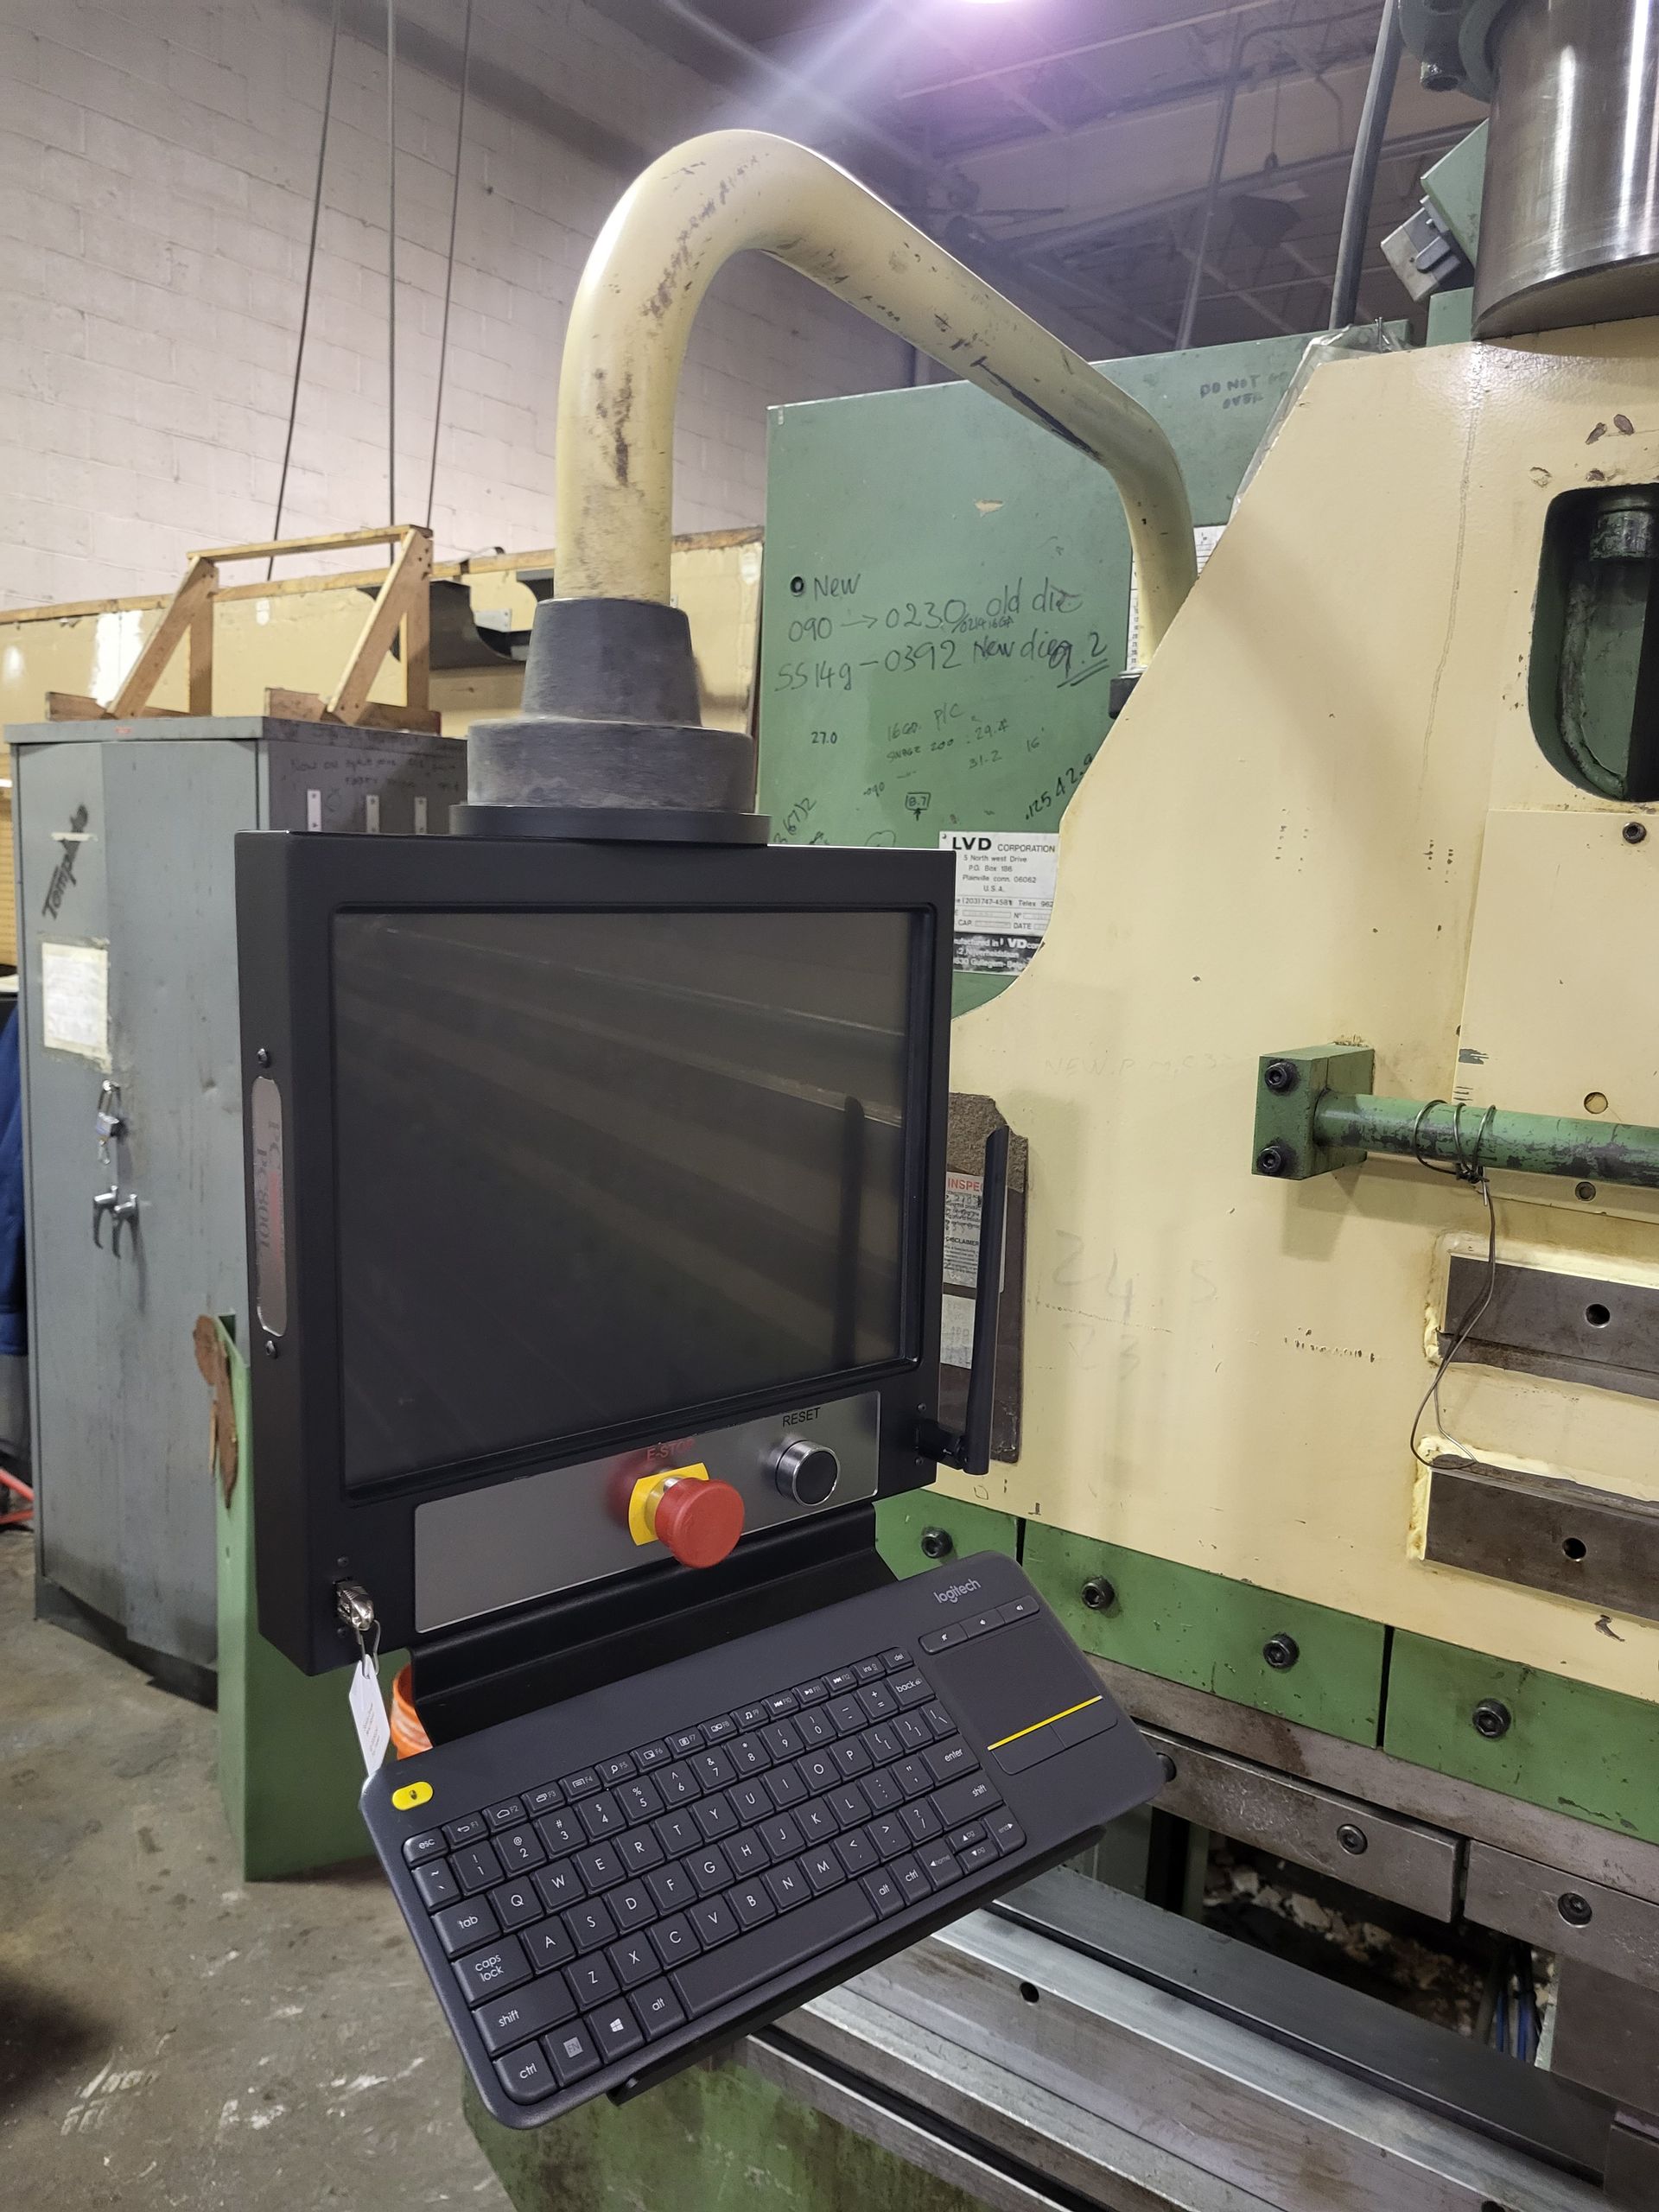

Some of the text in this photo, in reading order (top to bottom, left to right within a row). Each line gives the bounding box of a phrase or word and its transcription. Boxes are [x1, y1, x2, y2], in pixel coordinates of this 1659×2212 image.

[814, 574, 861, 601] New
[986, 576, 1022, 616] old
[788, 616, 832, 642] 090
[973, 636, 1014, 663] New
[811, 731, 838, 744] 27.0
[952, 836, 1055, 853] LVD CORPORATION
[782, 1407, 821, 1427] RESET
[933, 1579, 982, 1604] logitech
[896, 1681, 916, 1692] back
[847, 1751, 853, 1760] P
[945, 1749, 963, 1761] enter
[814, 1764, 823, 1774] O
[632, 1787, 641, 1796] %
[973, 1785, 987, 1796] shift
[640, 1798, 646, 1807] 5
[746, 1793, 754, 1803] U
[709, 1808, 717, 1819] Y
[811, 1813, 821, 1824] K
[673, 1825, 681, 1834] T
[780, 1829, 785, 1840] J
[968, 1830, 975, 1839] pg
[561, 1831, 569, 1840] 3
[419, 1838, 435, 1849] esc
[514, 1837, 522, 1846] @
[520, 1848, 528, 1858] 2
[635, 1842, 644, 1853] R
[741, 1845, 751, 1856] H
[976, 1846, 985, 1856] pg
[595, 1859, 605, 1870] E
[704, 1862, 715, 1872] G
[817, 1861, 830, 1872] M
[906, 1870, 918, 1881] ctrl
[552, 1875, 564, 1888] W
[667, 1879, 673, 1891] F
[783, 1878, 793, 1889] N
[880, 1885, 889, 1895] alt
[512, 1895, 524, 1906] Q
[626, 1898, 636, 1910] D
[747, 1896, 756, 1906] B
[459, 1916, 478, 1929] tab
[588, 1916, 595, 1927] S
[709, 1912, 717, 1923] V
[546, 1936, 556, 1948] A
[670, 1931, 681, 1942] C
[629, 1951, 639, 1964] X
[475, 1955, 501, 1972] caps
[480, 1965, 503, 1982] lock
[588, 1971, 598, 1983] Z
[652, 1998, 664, 2010] alt
[499, 2010, 519, 2026] shift
[520, 2063, 537, 2078] ctrl
